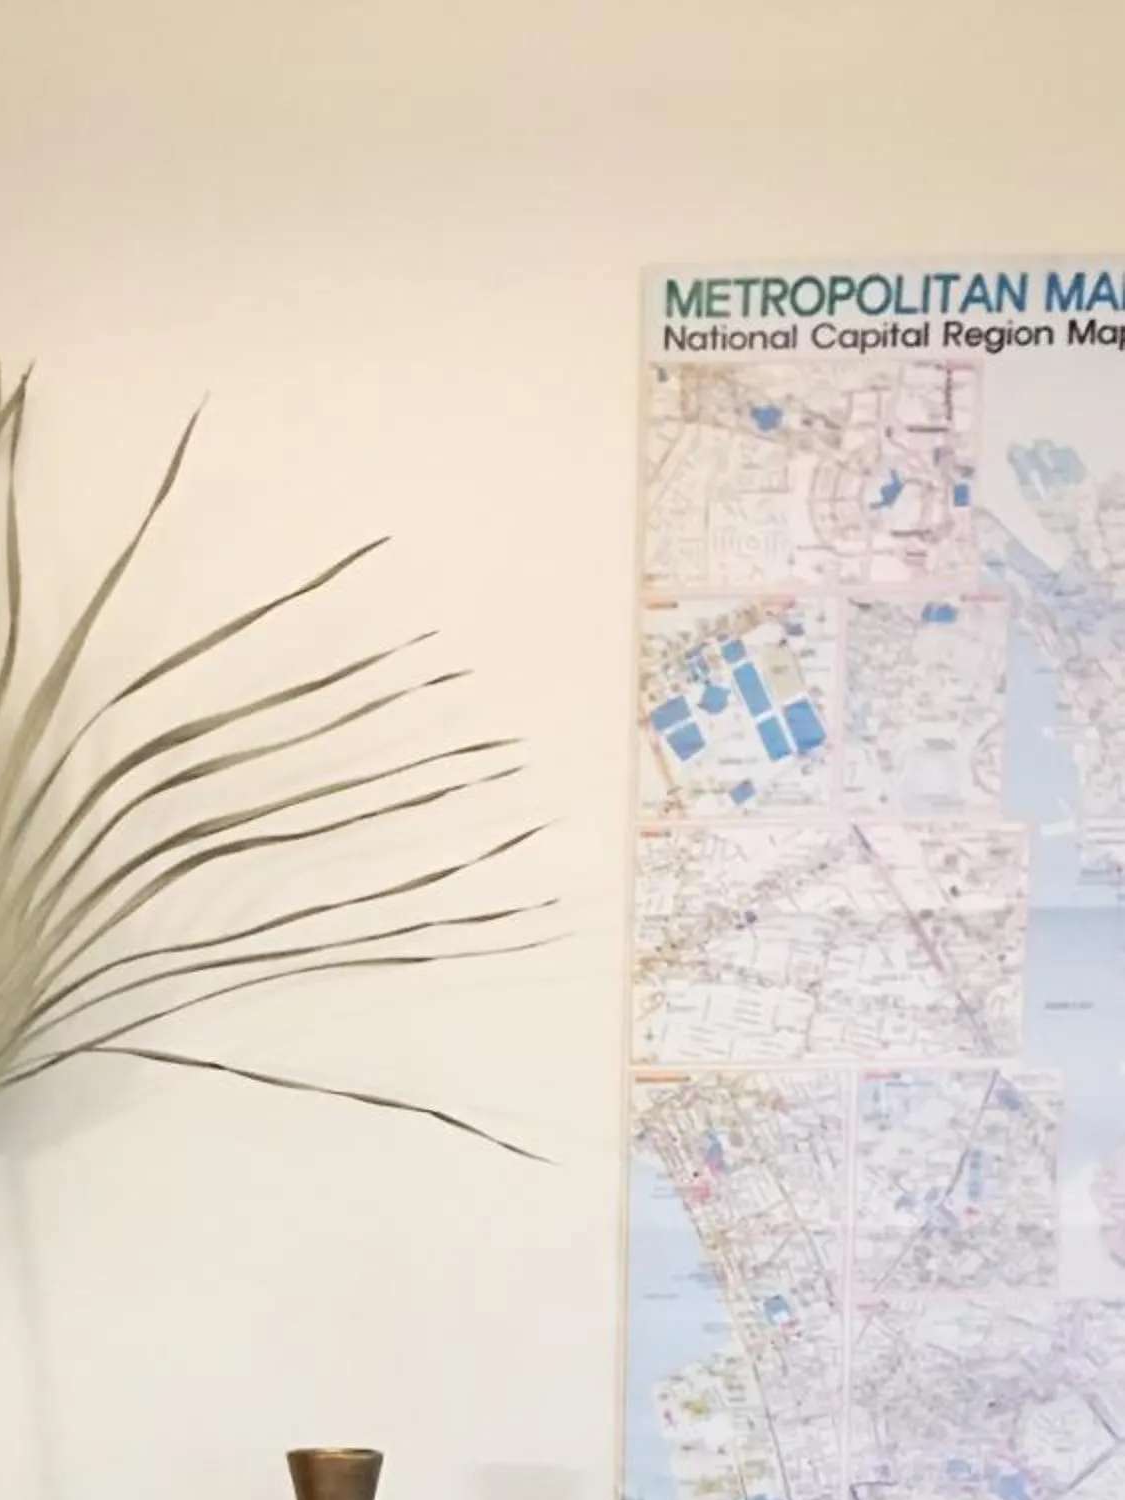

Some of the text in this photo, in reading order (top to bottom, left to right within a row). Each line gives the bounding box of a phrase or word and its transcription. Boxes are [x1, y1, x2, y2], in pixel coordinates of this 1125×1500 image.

[664, 271, 1125, 319] METROPOLITAN MA
[663, 324, 798, 352] National
[811, 321, 930, 355] Capital
[942, 319, 1055, 355] Region
